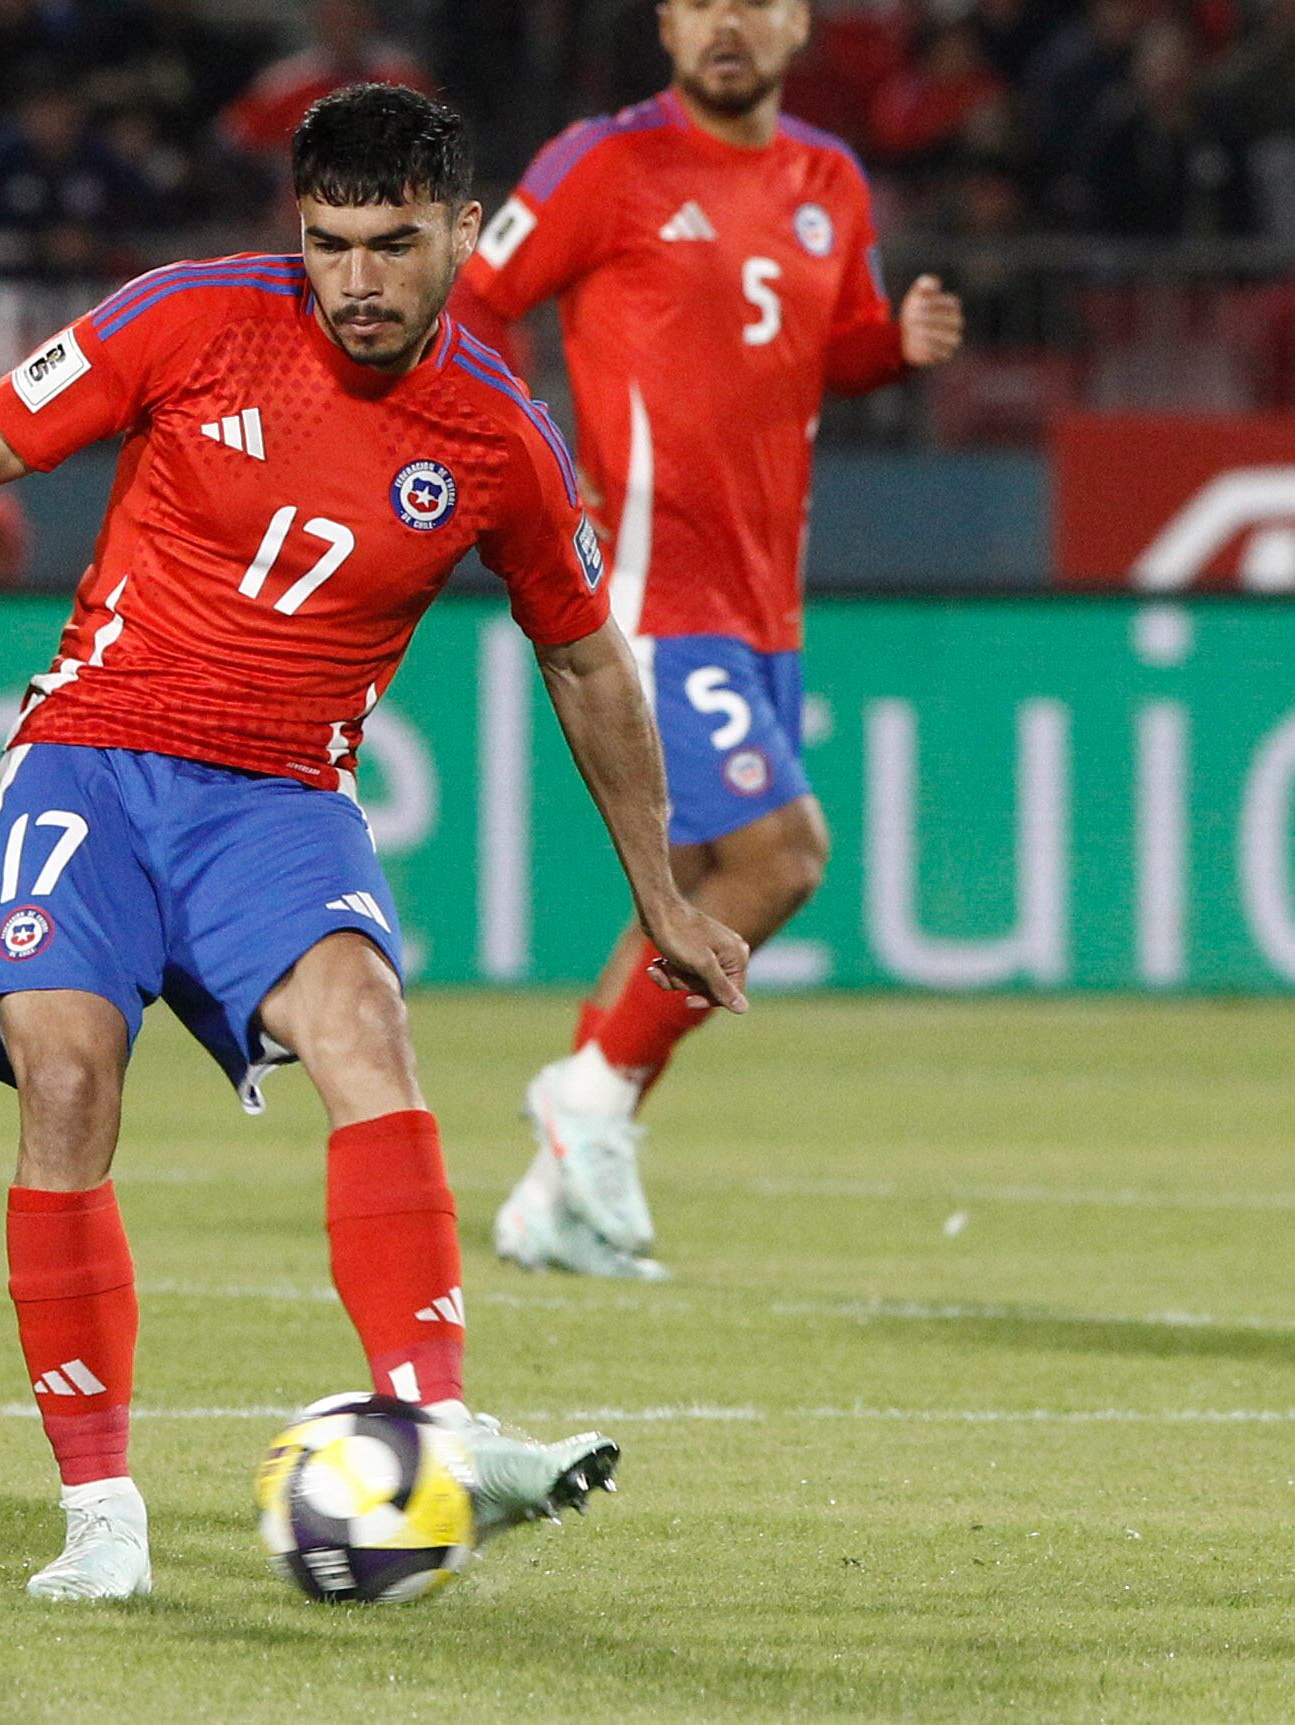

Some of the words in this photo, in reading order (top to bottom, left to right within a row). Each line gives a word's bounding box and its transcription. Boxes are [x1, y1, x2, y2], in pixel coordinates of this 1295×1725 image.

[742, 256, 783, 346] 5
[237, 505, 356, 616] 17
[684, 665, 752, 751] 5
[0, 809, 90, 904] 17
